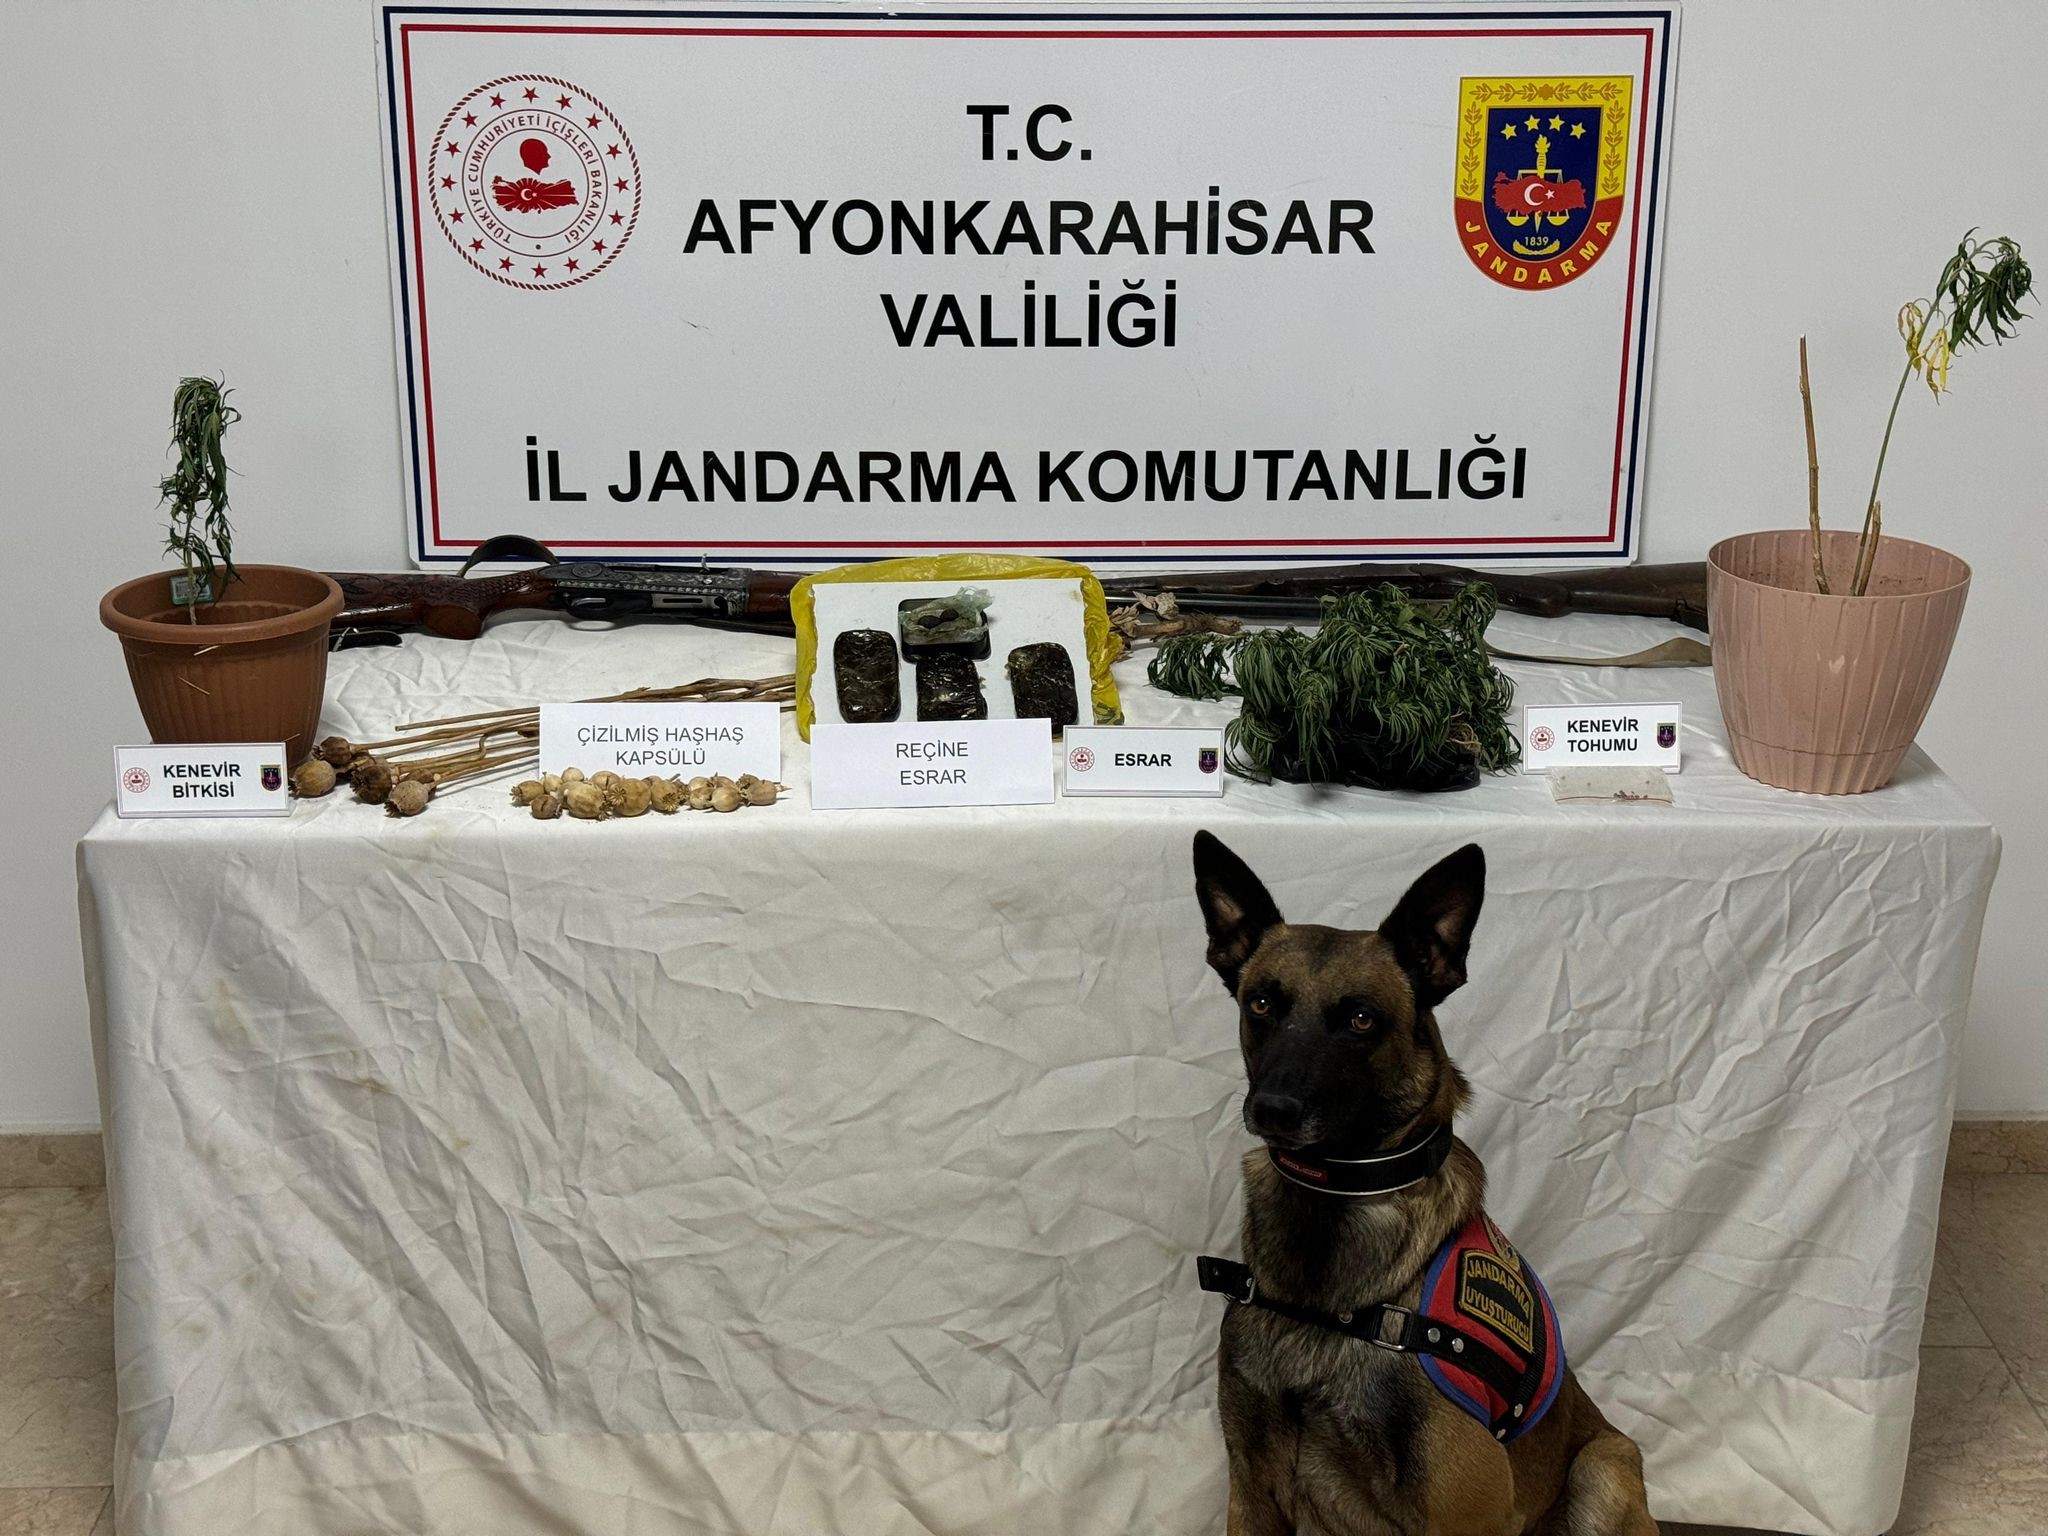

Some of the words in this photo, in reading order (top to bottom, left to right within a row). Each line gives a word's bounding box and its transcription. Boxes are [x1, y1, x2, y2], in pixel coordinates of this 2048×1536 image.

[468, 113, 541, 182] CUMHURİYETİ
[546, 115, 600, 166] İÇİŞLERİ
[967, 104, 1091, 161] T.C.
[469, 189, 512, 244] TÜRKİYE
[564, 169, 603, 244] BAKANLIĞI
[683, 186, 1375, 255] AFYONKARAHİSAR
[1465, 220, 1613, 284] JANDARMA
[1524, 235, 1549, 247] 1839
[880, 279, 1177, 349] VALİLİĞİ
[526, 436, 588, 502] İL
[608, 450, 1017, 503] JANDARMA
[1039, 434, 1527, 503] KOMUTANLIĞI
[577, 722, 659, 746] ÇİZİLMİŞ
[665, 726, 744, 746] HAŞHAŞ
[1567, 715, 1639, 733] KENEVİR
[616, 747, 706, 766] KAPSÜLÜ
[896, 740, 970, 762] REÇİNE
[1114, 753, 1172, 767] ESRAR
[1567, 738, 1638, 753] TOHUMU
[163, 761, 242, 779] KENEVİR
[899, 769, 967, 787] ESRAR
[172, 781, 235, 799] BİTKİSİ
[1467, 1258, 1530, 1320] JANDARMA
